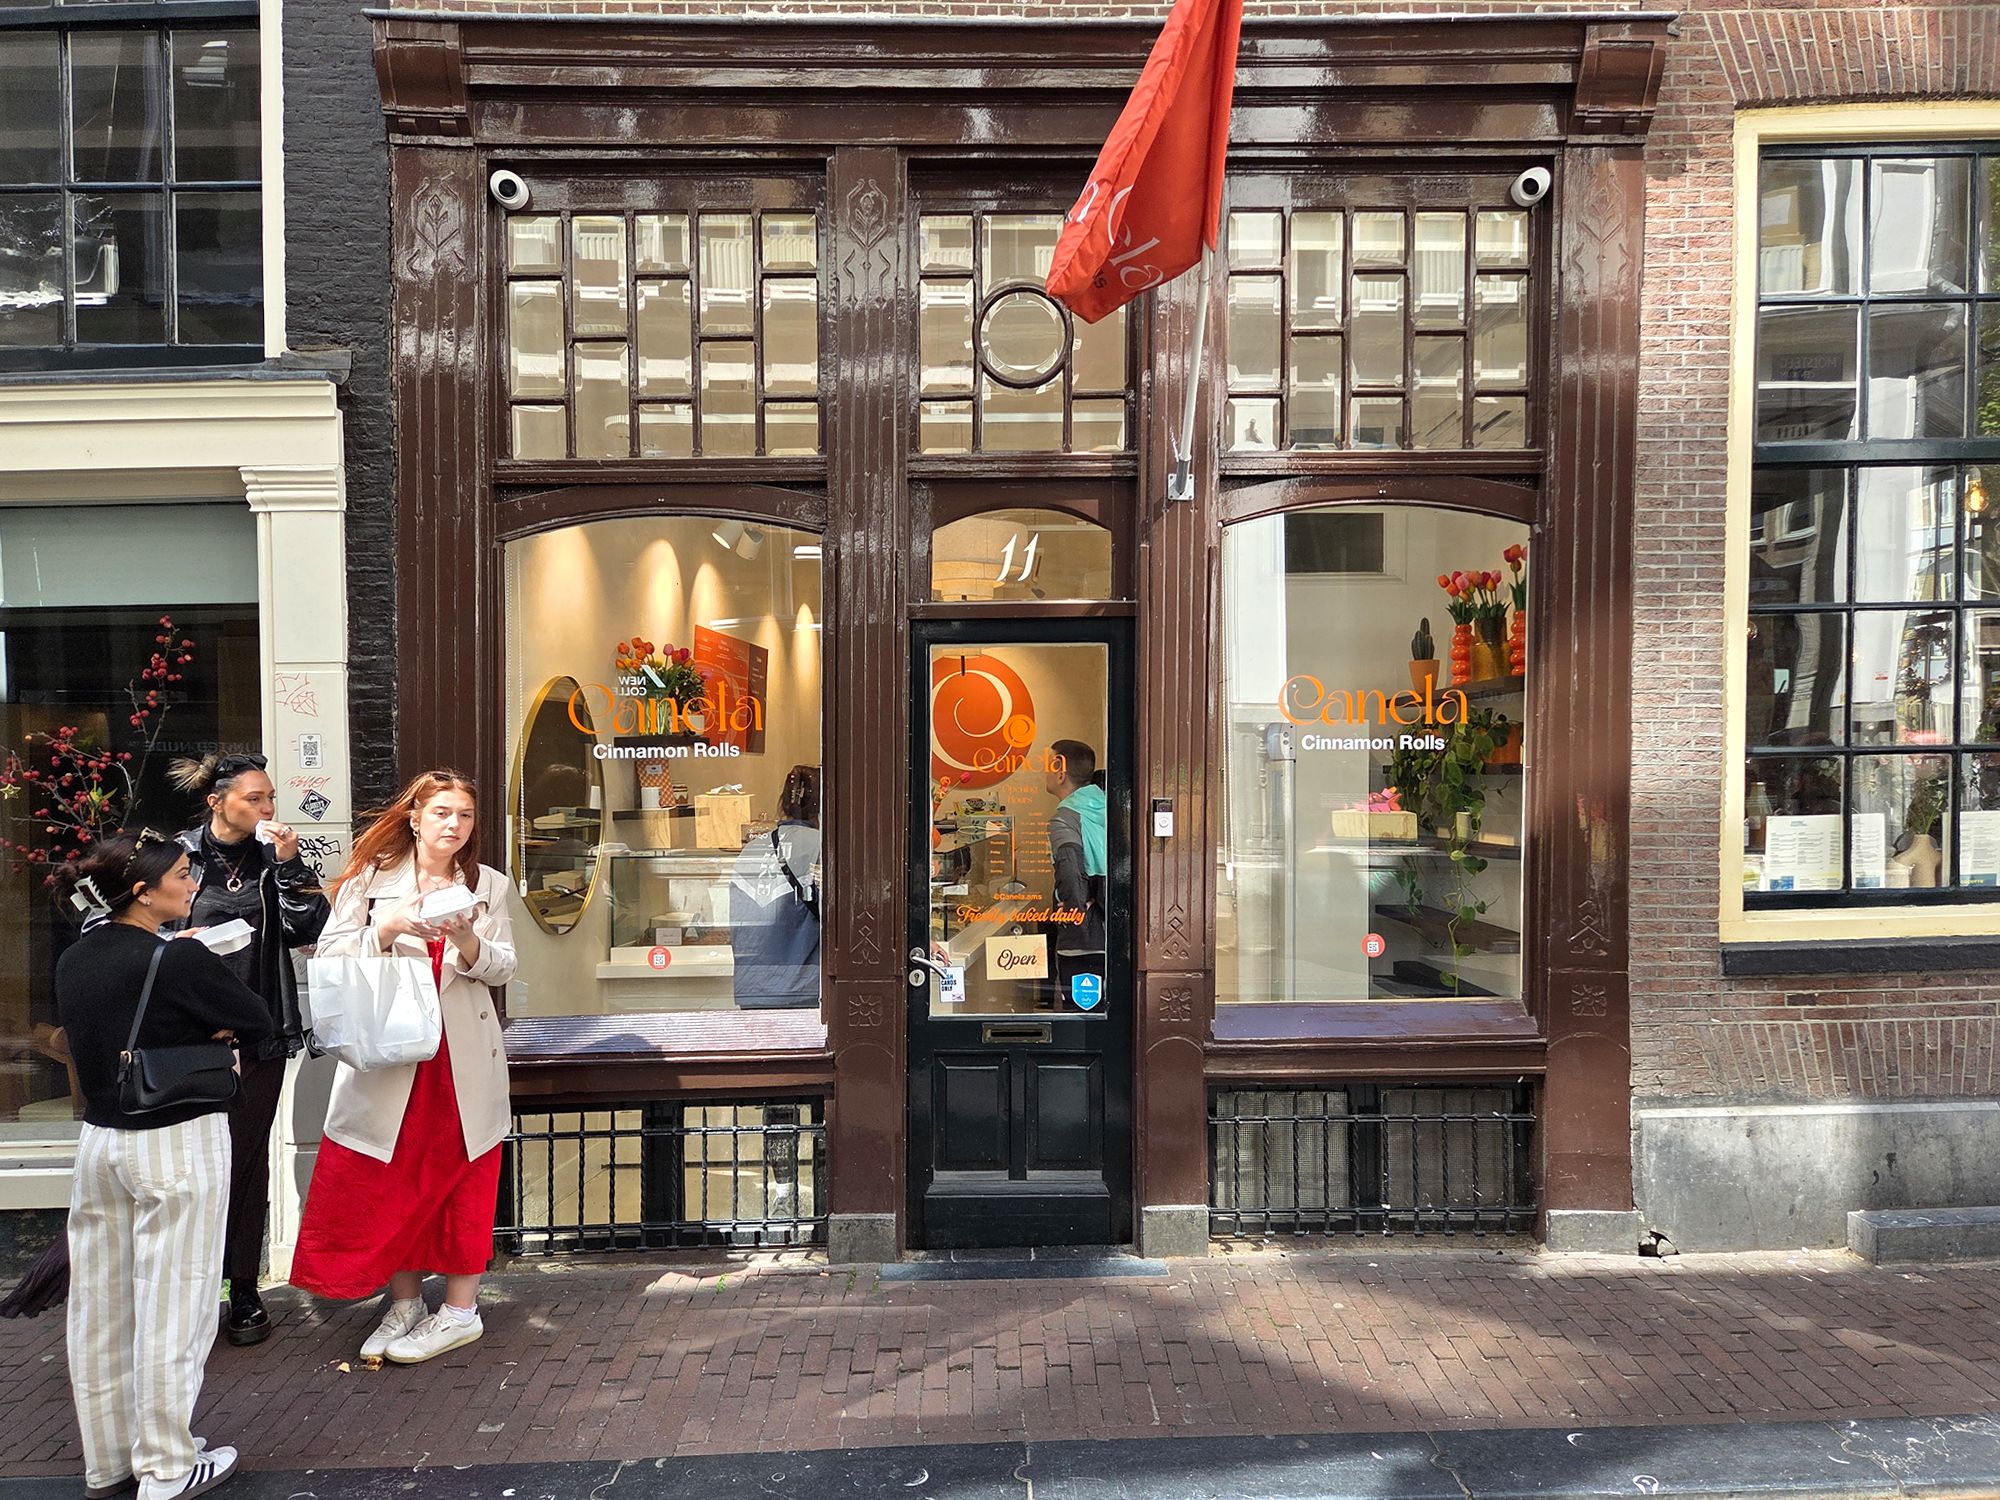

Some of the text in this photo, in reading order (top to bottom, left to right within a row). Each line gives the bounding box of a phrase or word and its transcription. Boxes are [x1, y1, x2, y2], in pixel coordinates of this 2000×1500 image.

[996, 532, 1039, 582] 11
[567, 680, 764, 735] Canela
[1278, 673, 1469, 726] Canela
[593, 742, 740, 759] Cinnamon Rolls
[1301, 734, 1446, 750] Cinnamon Rolls
[972, 745, 1067, 774] Canela
[1010, 907, 1048, 922] baked
[1050, 907, 1086, 925] daily
[997, 949, 1038, 970] Open
